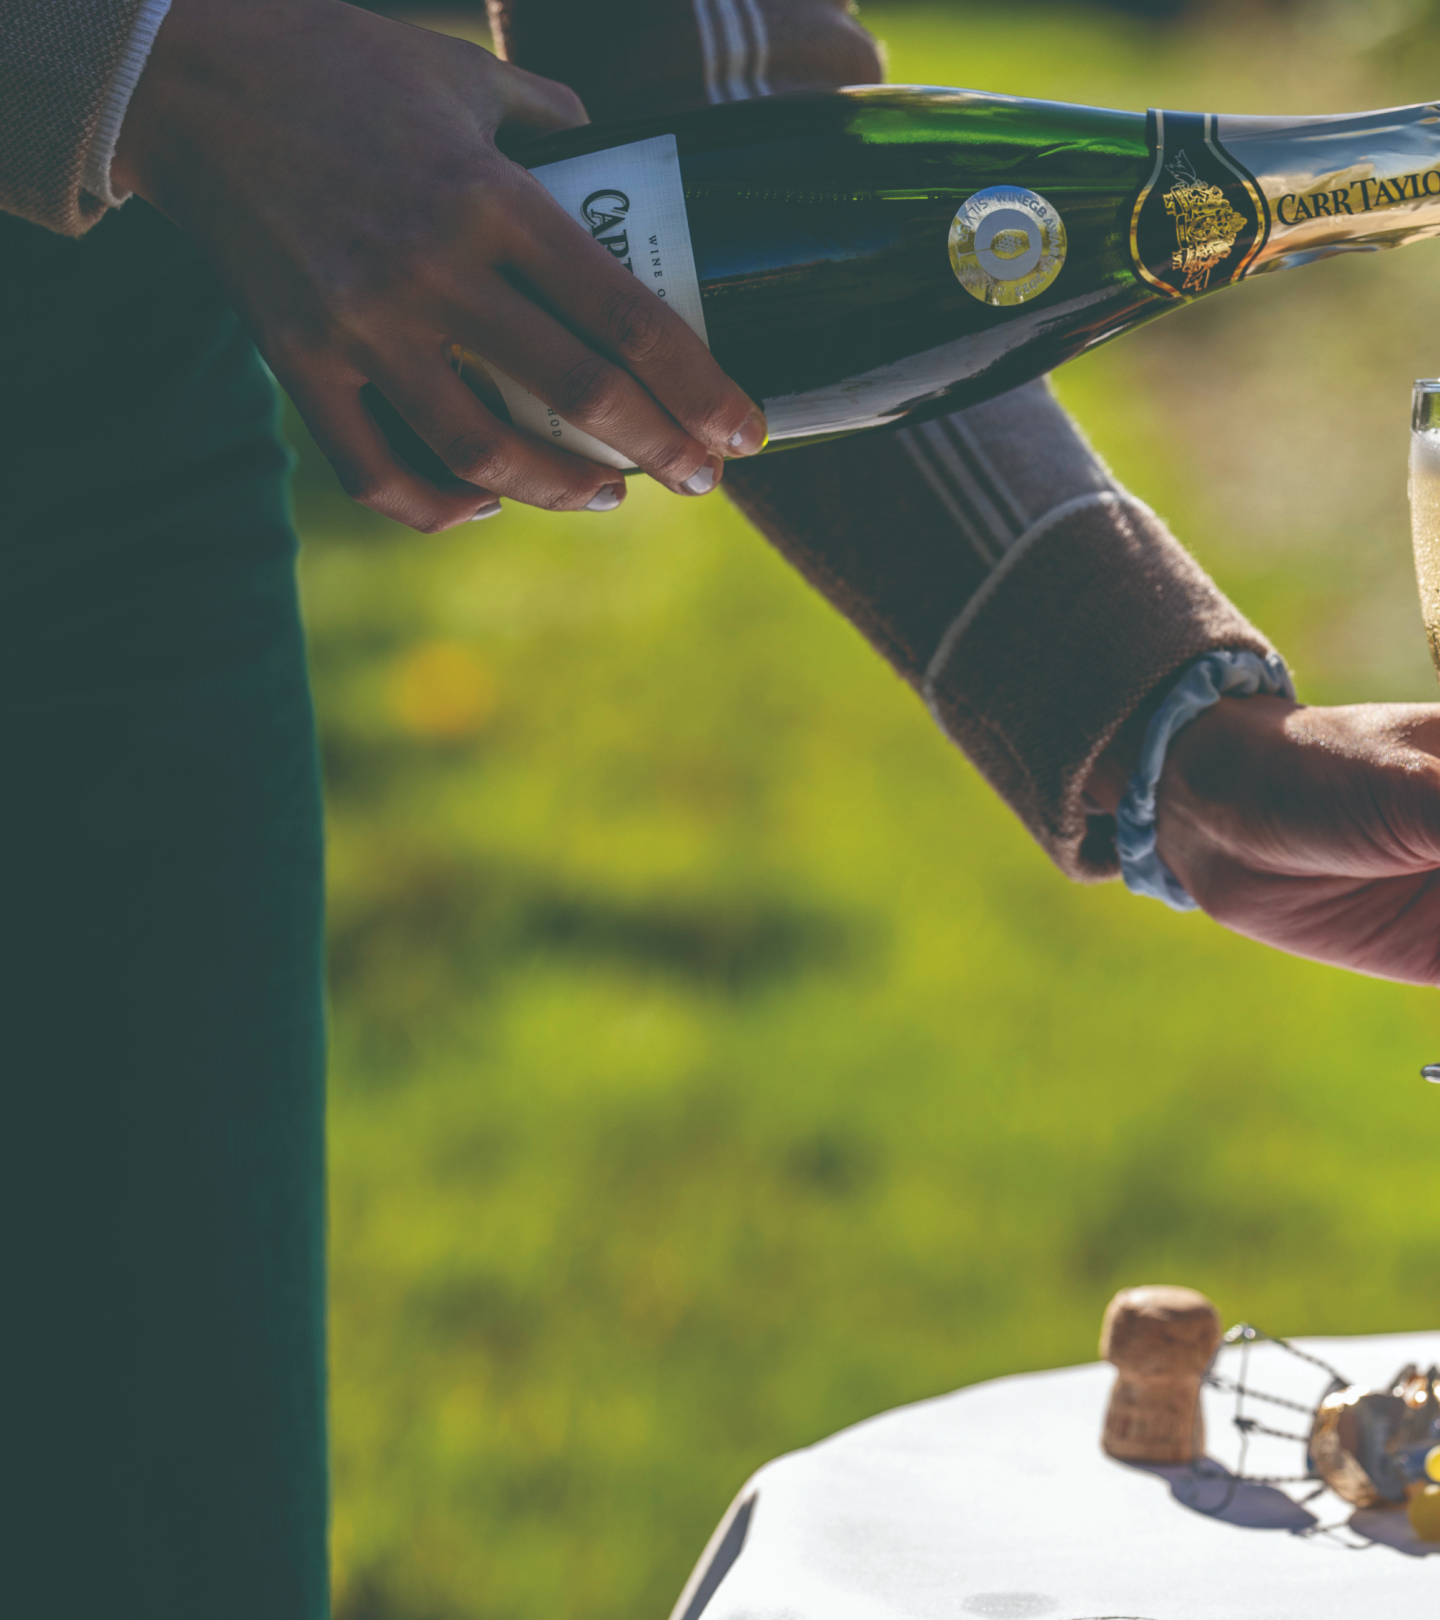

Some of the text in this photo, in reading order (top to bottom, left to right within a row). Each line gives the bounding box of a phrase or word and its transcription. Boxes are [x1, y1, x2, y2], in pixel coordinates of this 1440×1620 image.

[957, 198, 989, 243] SILVER
[1162, 193, 1177, 217] EST
[1276, 188, 1354, 226] CARR
[994, 191, 1061, 297] WINEGB AWARDS 2022
[648, 235, 668, 304] WINE O
